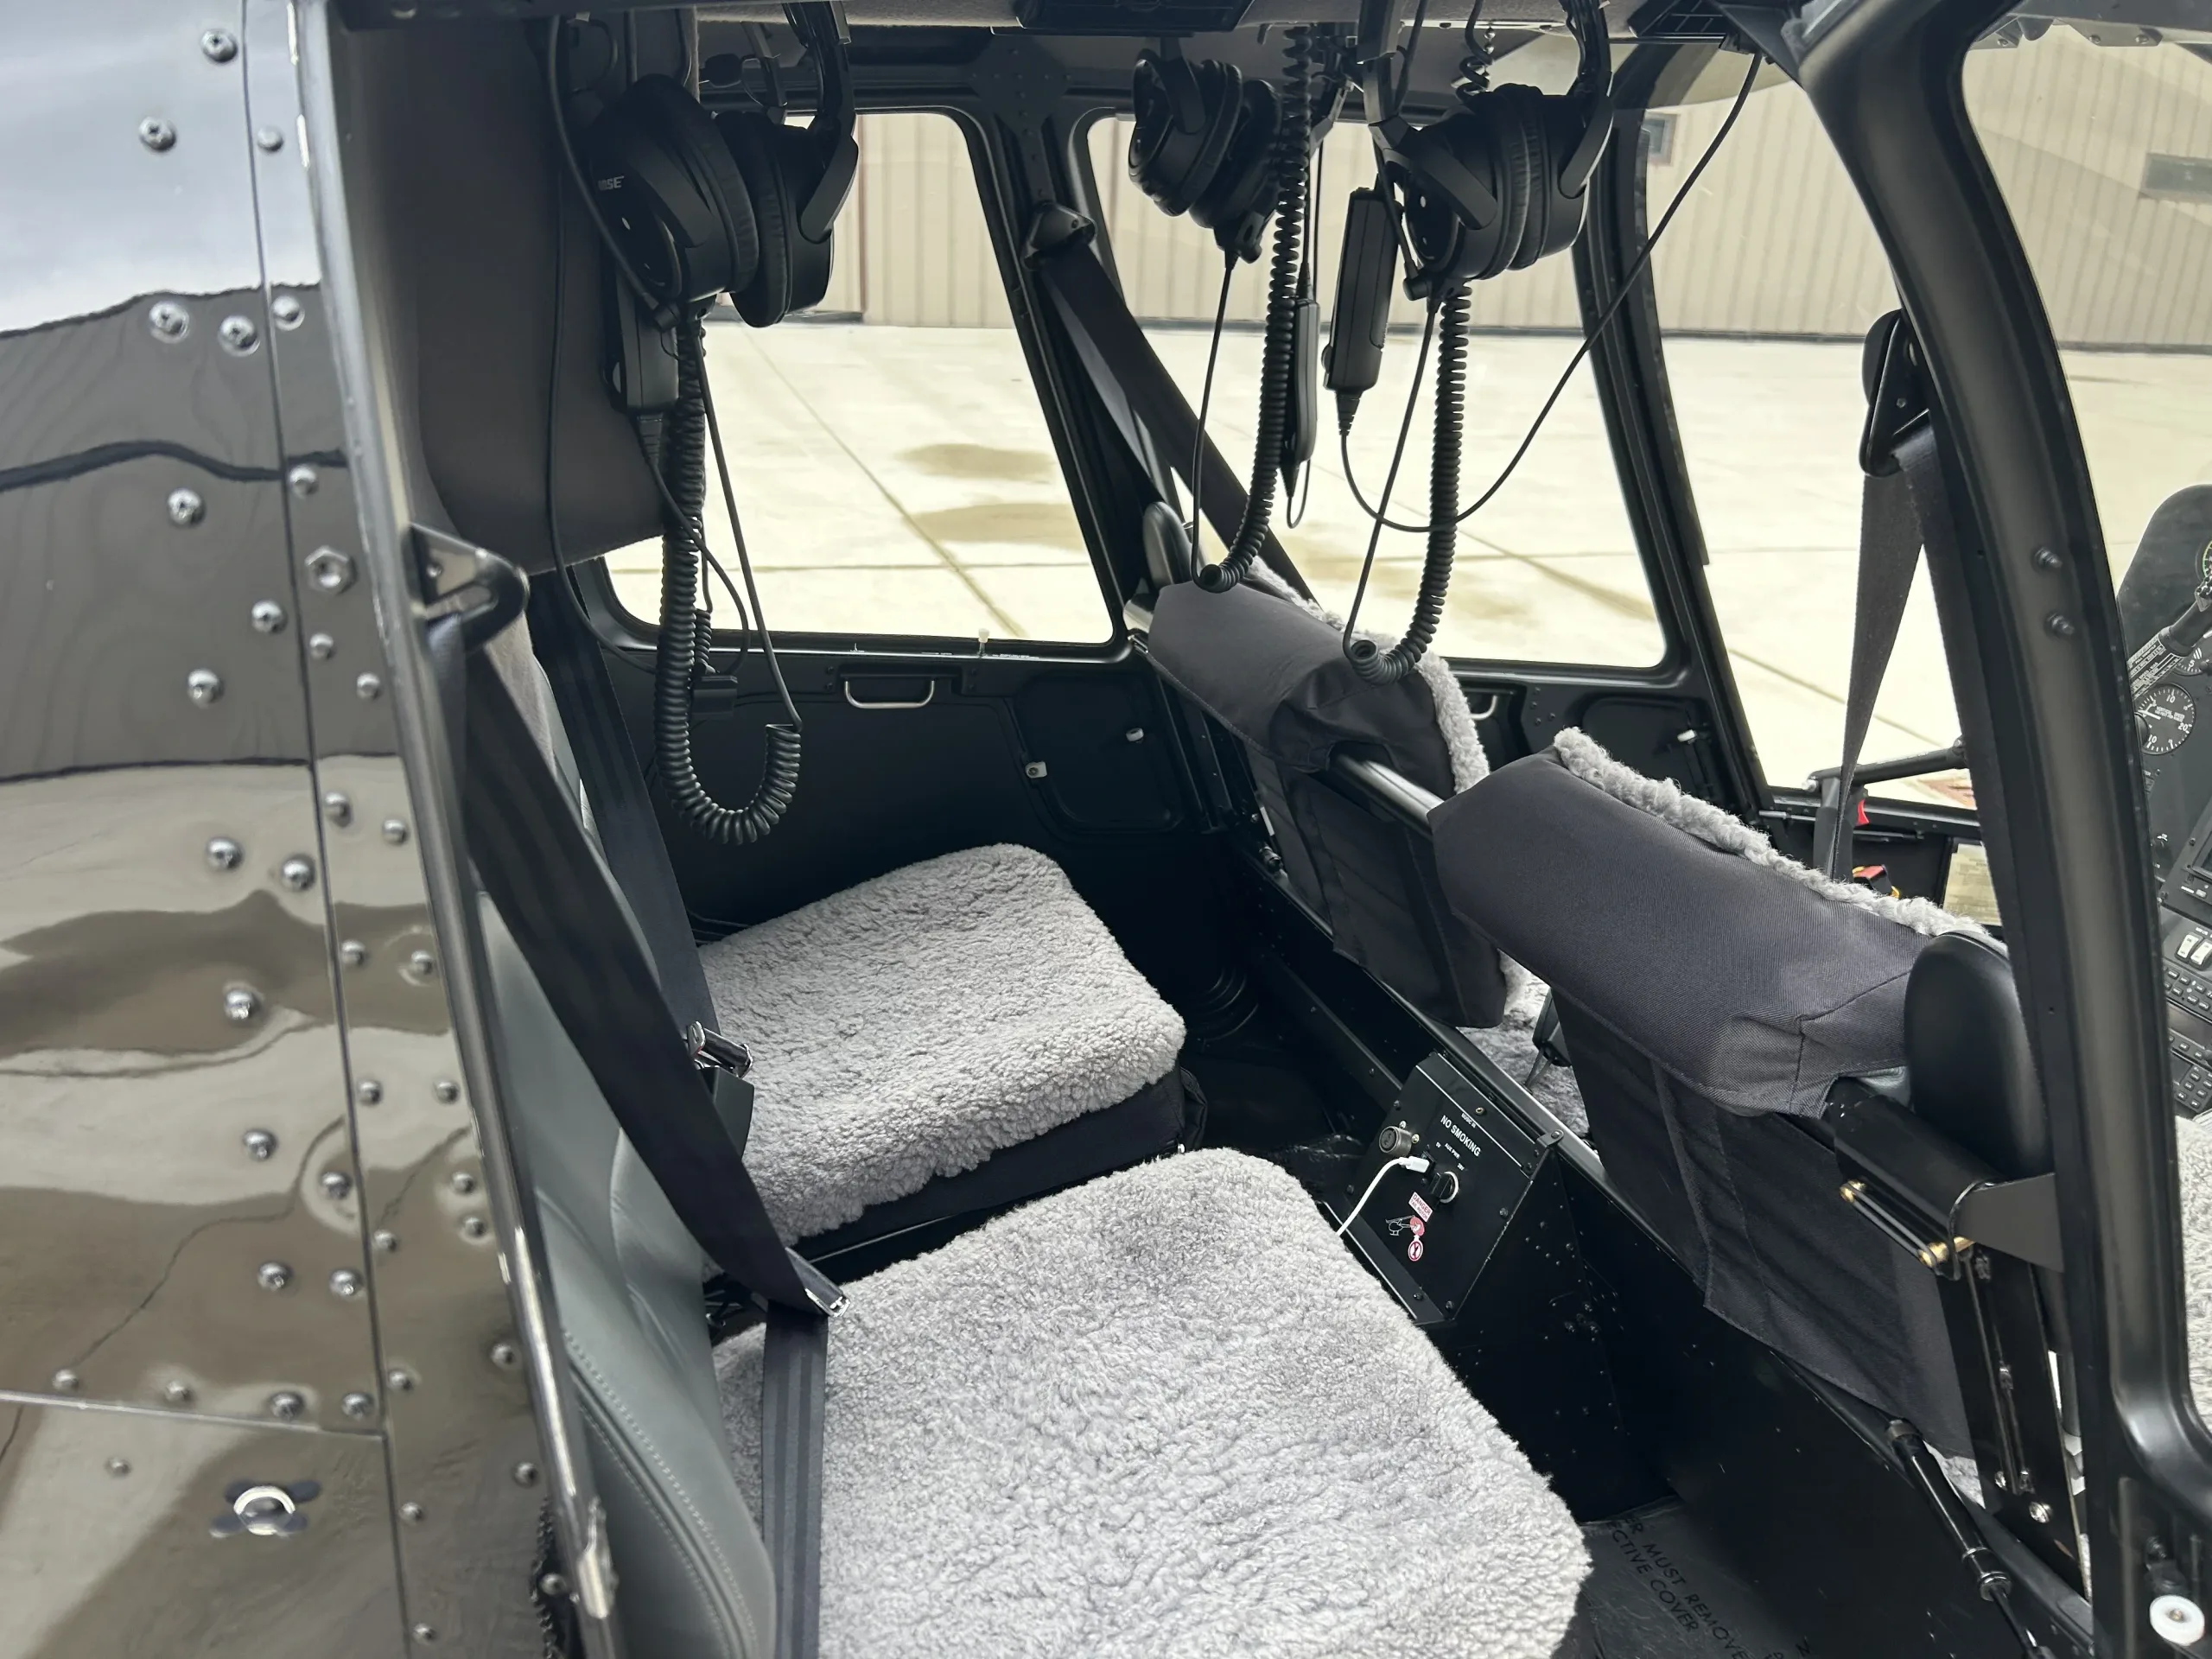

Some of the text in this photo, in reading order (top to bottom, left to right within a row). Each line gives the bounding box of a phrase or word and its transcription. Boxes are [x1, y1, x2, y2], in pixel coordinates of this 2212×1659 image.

[2166, 695, 2176, 703] 10
[2177, 722, 2189, 731] 20
[2148, 734, 2158, 744] 10
[1440, 1115, 1481, 1157] NO SMOKING
[1413, 1193, 1432, 1216] DANGER
[1643, 1542, 1686, 1585] MUST
[1685, 1593, 1749, 1659] REMOVE
[1650, 1580, 1700, 1632] COVER
